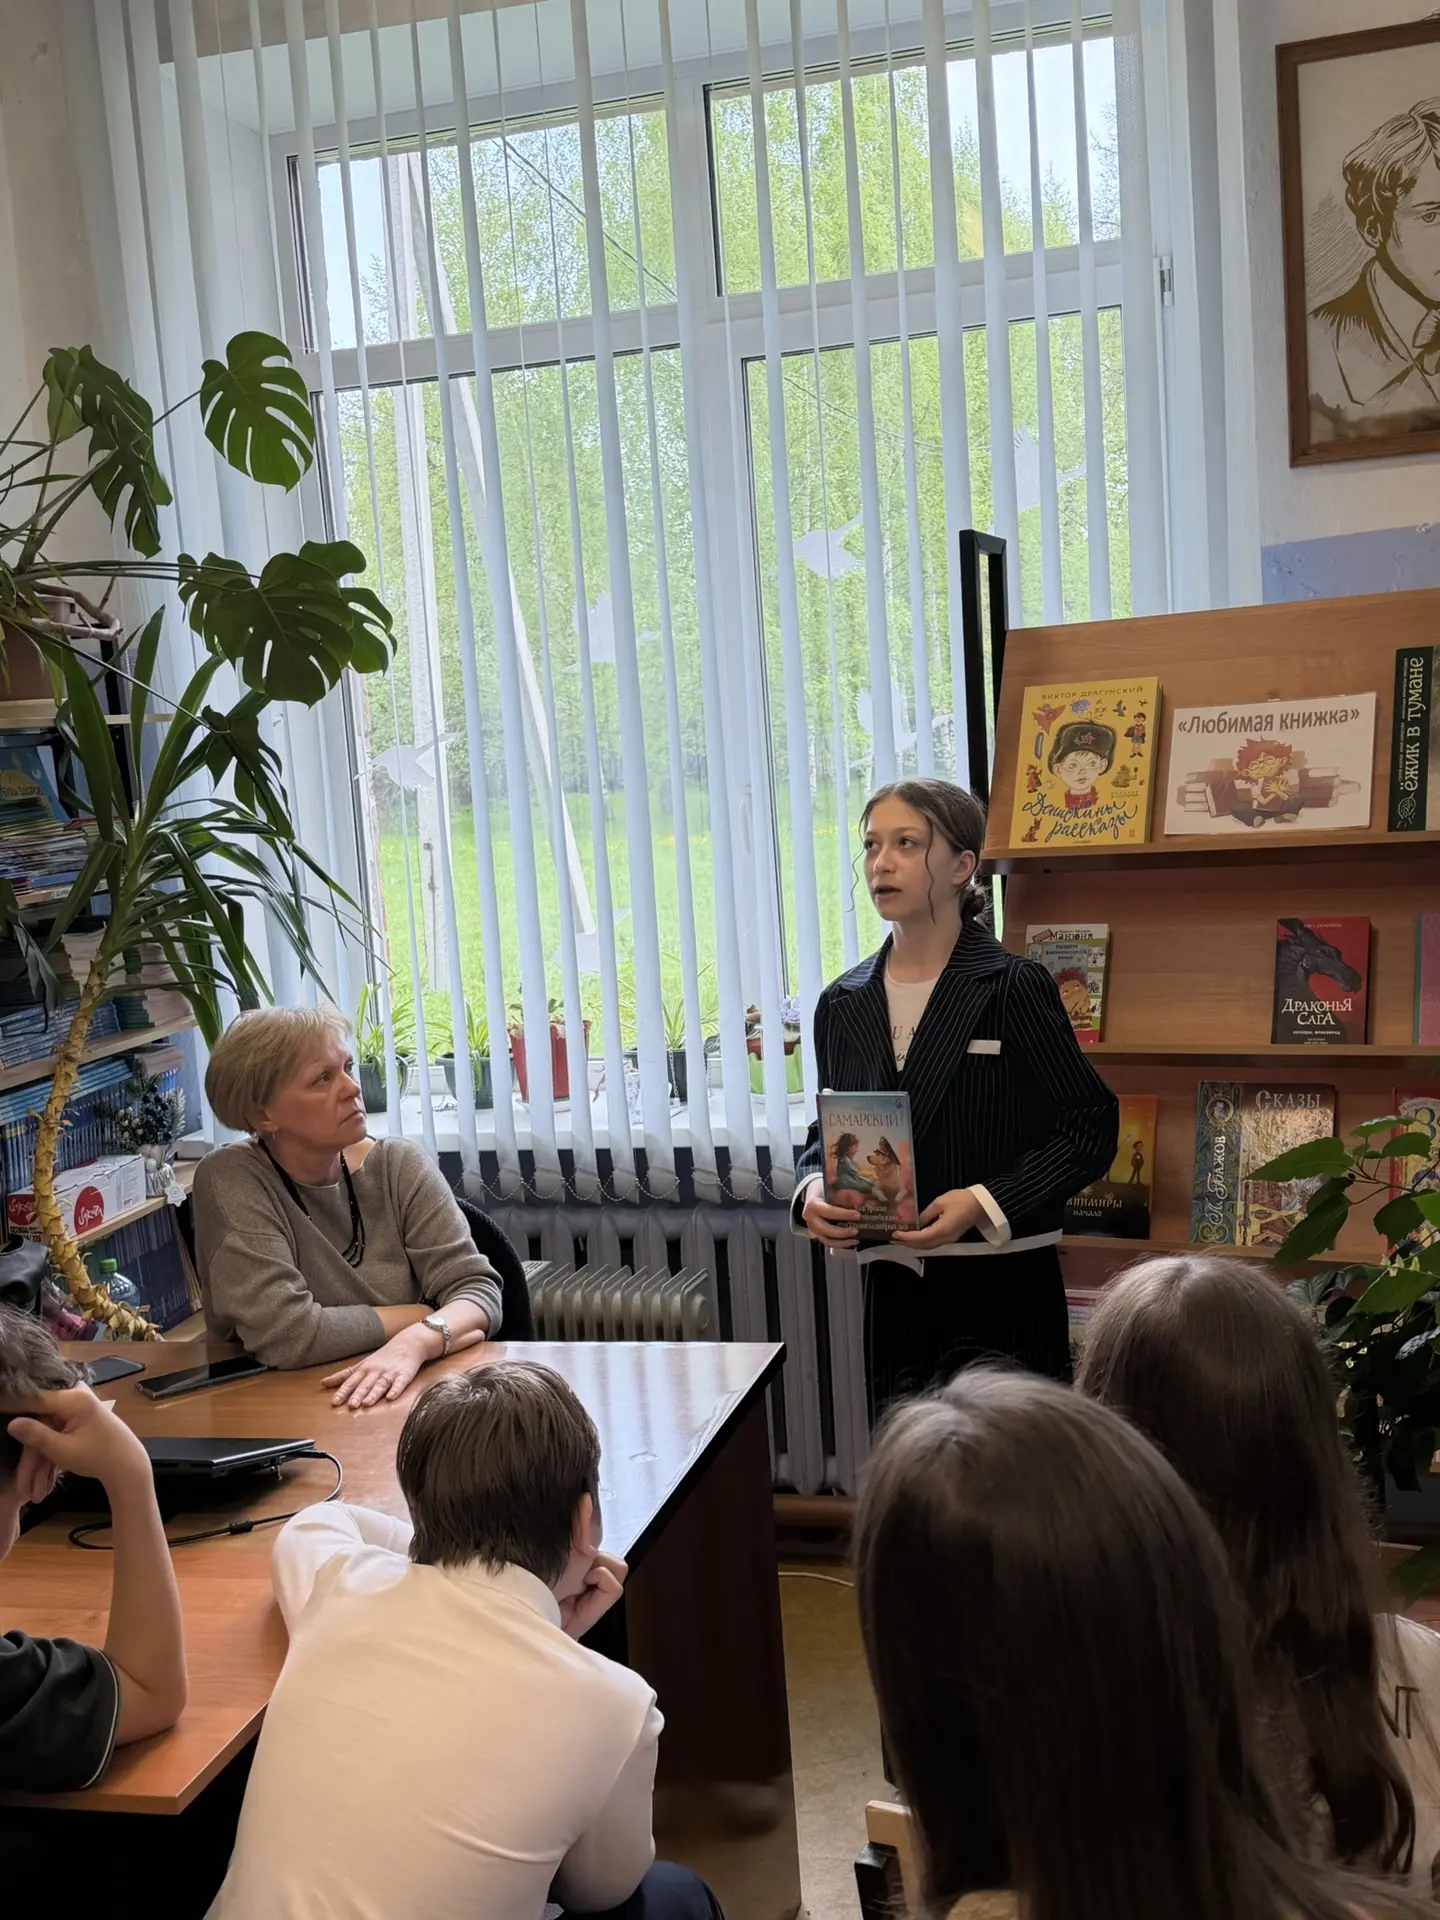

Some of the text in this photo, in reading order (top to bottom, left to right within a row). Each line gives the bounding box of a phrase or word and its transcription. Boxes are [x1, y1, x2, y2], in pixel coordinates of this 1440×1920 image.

[1041, 686, 1143, 700] ВИКТОР ДРАГУНСКИЙ
[1407, 657, 1427, 721] тумане
[1178, 708, 1360, 733] «Любимая книжка»
[1407, 726, 1420, 737] в
[1399, 743, 1420, 792] ёжик
[1044, 804, 1138, 843] рассказы
[1281, 998, 1353, 1013] ДРАКОНЬЯ
[828, 1111, 899, 1127] САМАРСКИЙ
